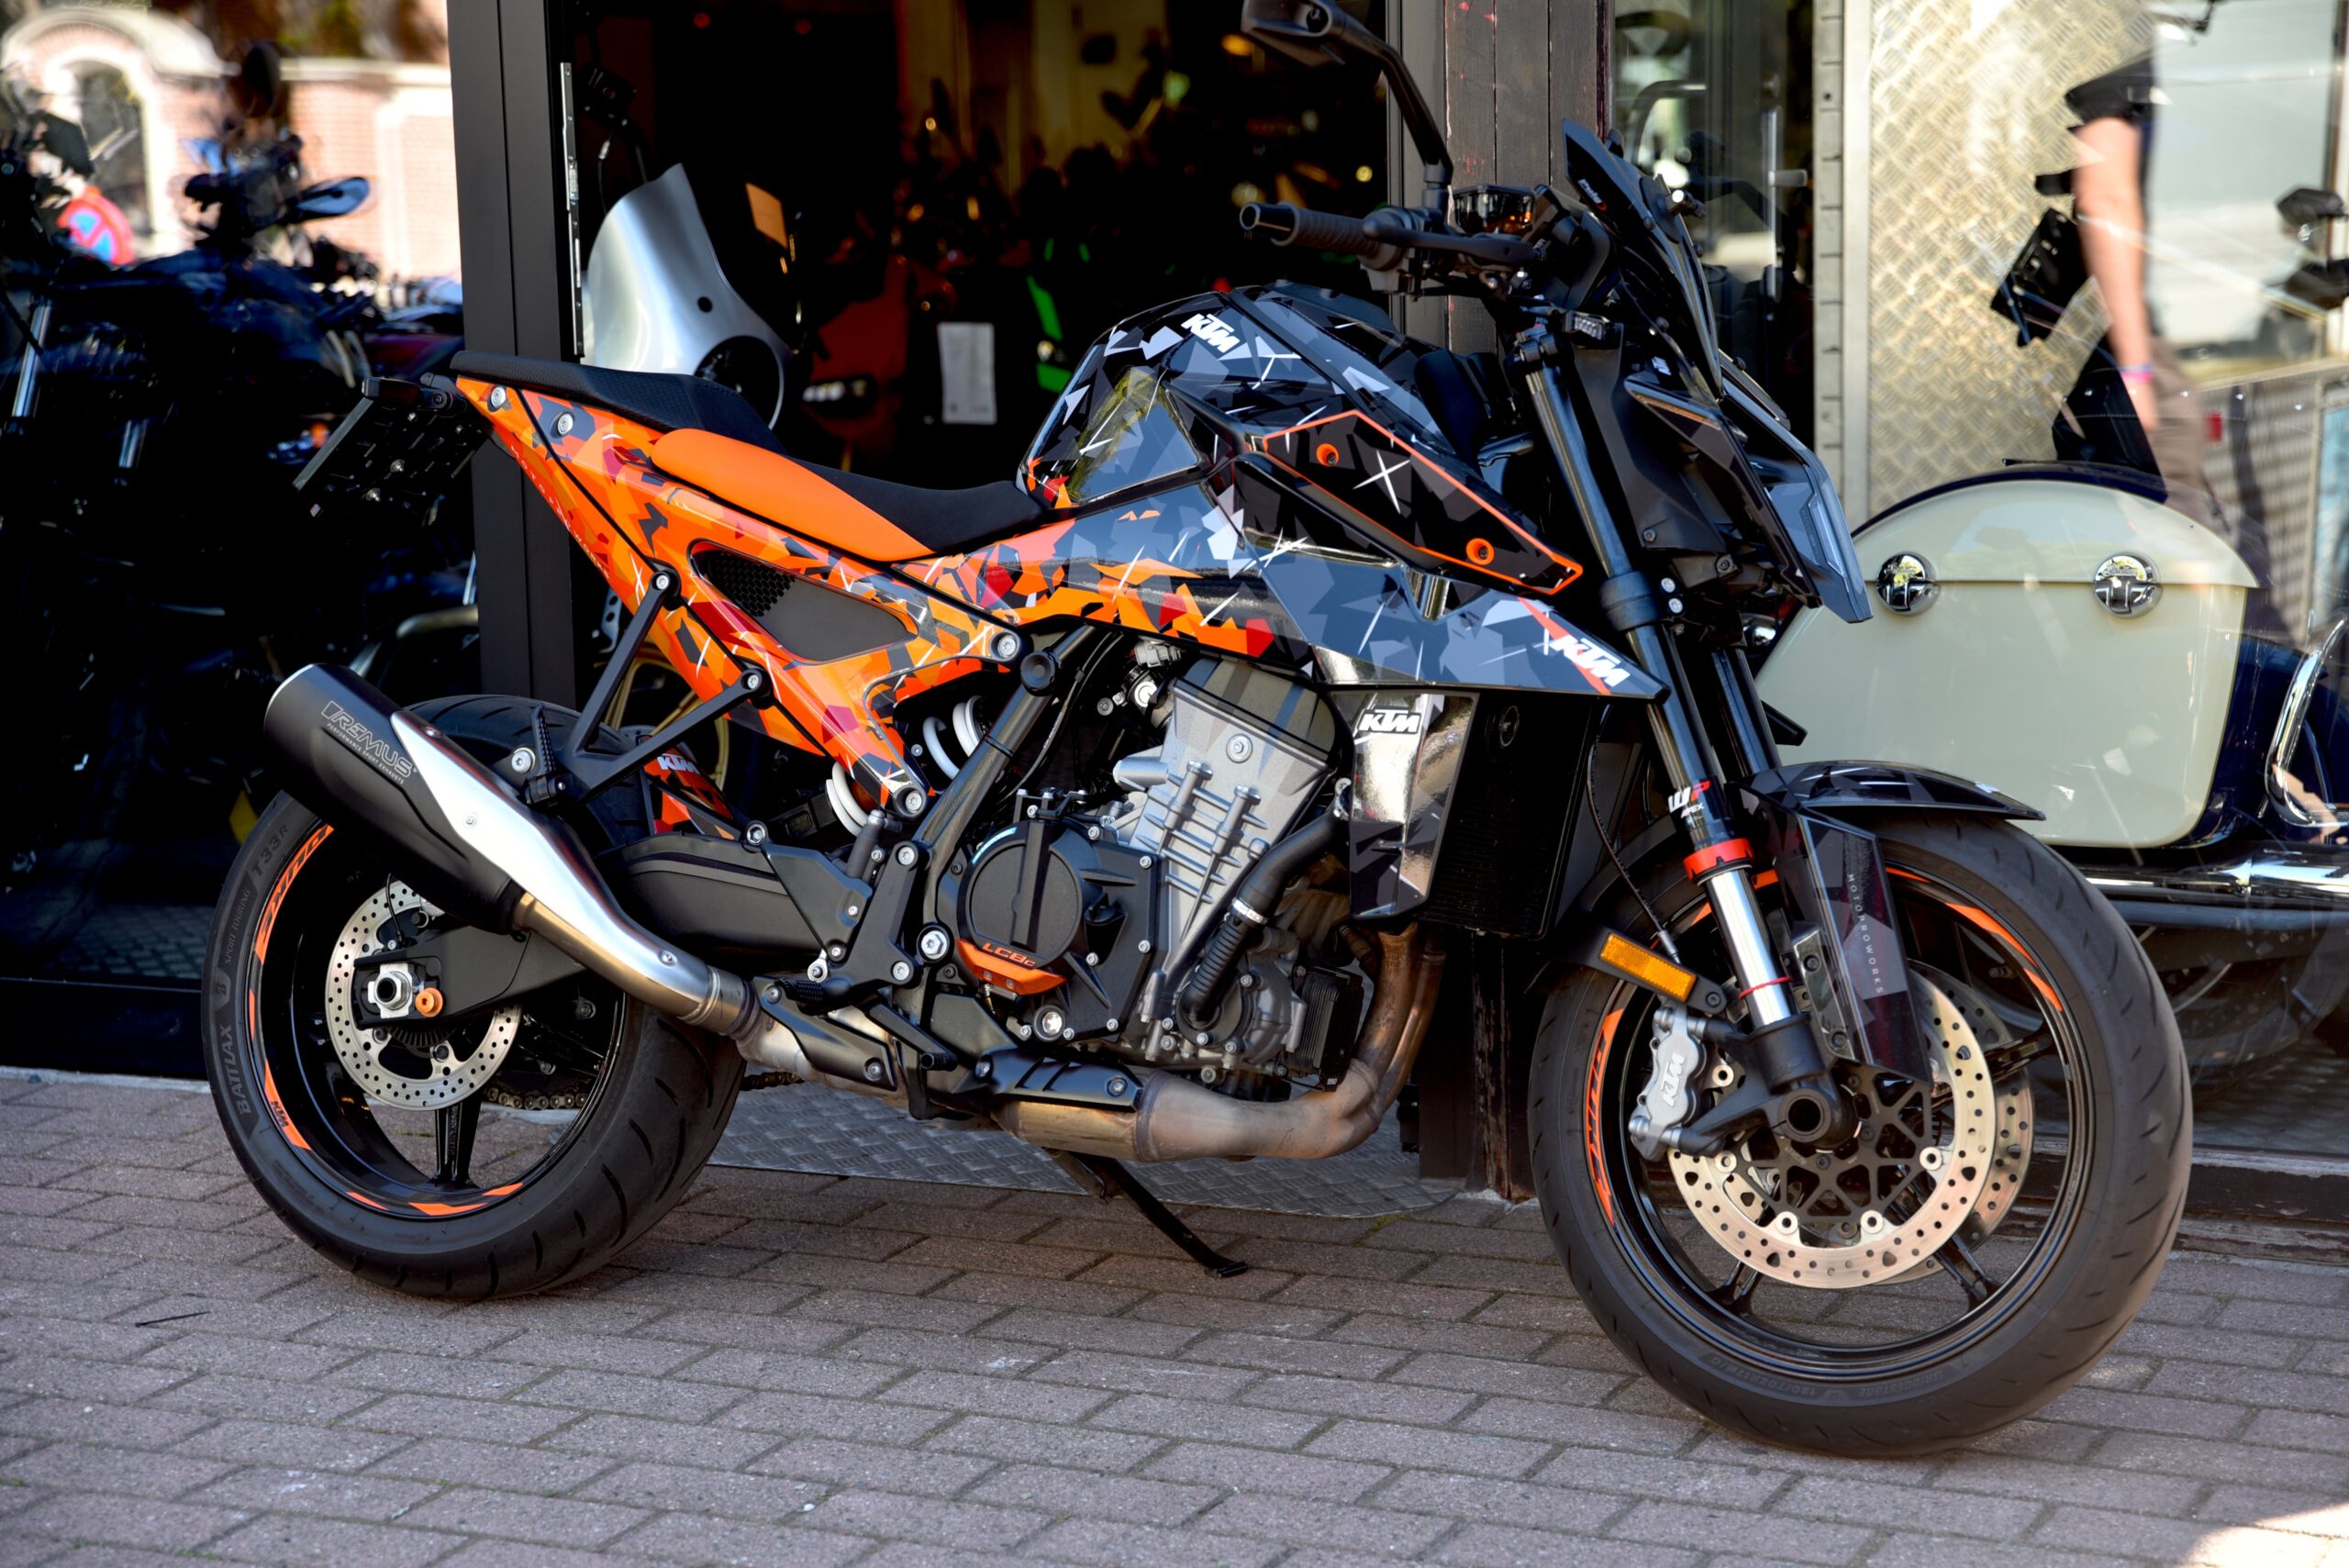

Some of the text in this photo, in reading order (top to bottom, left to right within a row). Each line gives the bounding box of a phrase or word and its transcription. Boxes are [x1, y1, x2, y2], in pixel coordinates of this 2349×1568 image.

[1181, 313, 1241, 353] KTM
[1549, 634, 1631, 687] KTM
[331, 710, 413, 778] REMUS
[1358, 708, 1420, 732] KTM
[327, 722, 405, 784] PERFORMANCE SPORT EXHAUSTS
[657, 753, 701, 775] KTM
[1668, 780, 1710, 813] WP
[219, 1024, 251, 1116] BATTLAX
[1661, 1051, 1685, 1107] KTM
